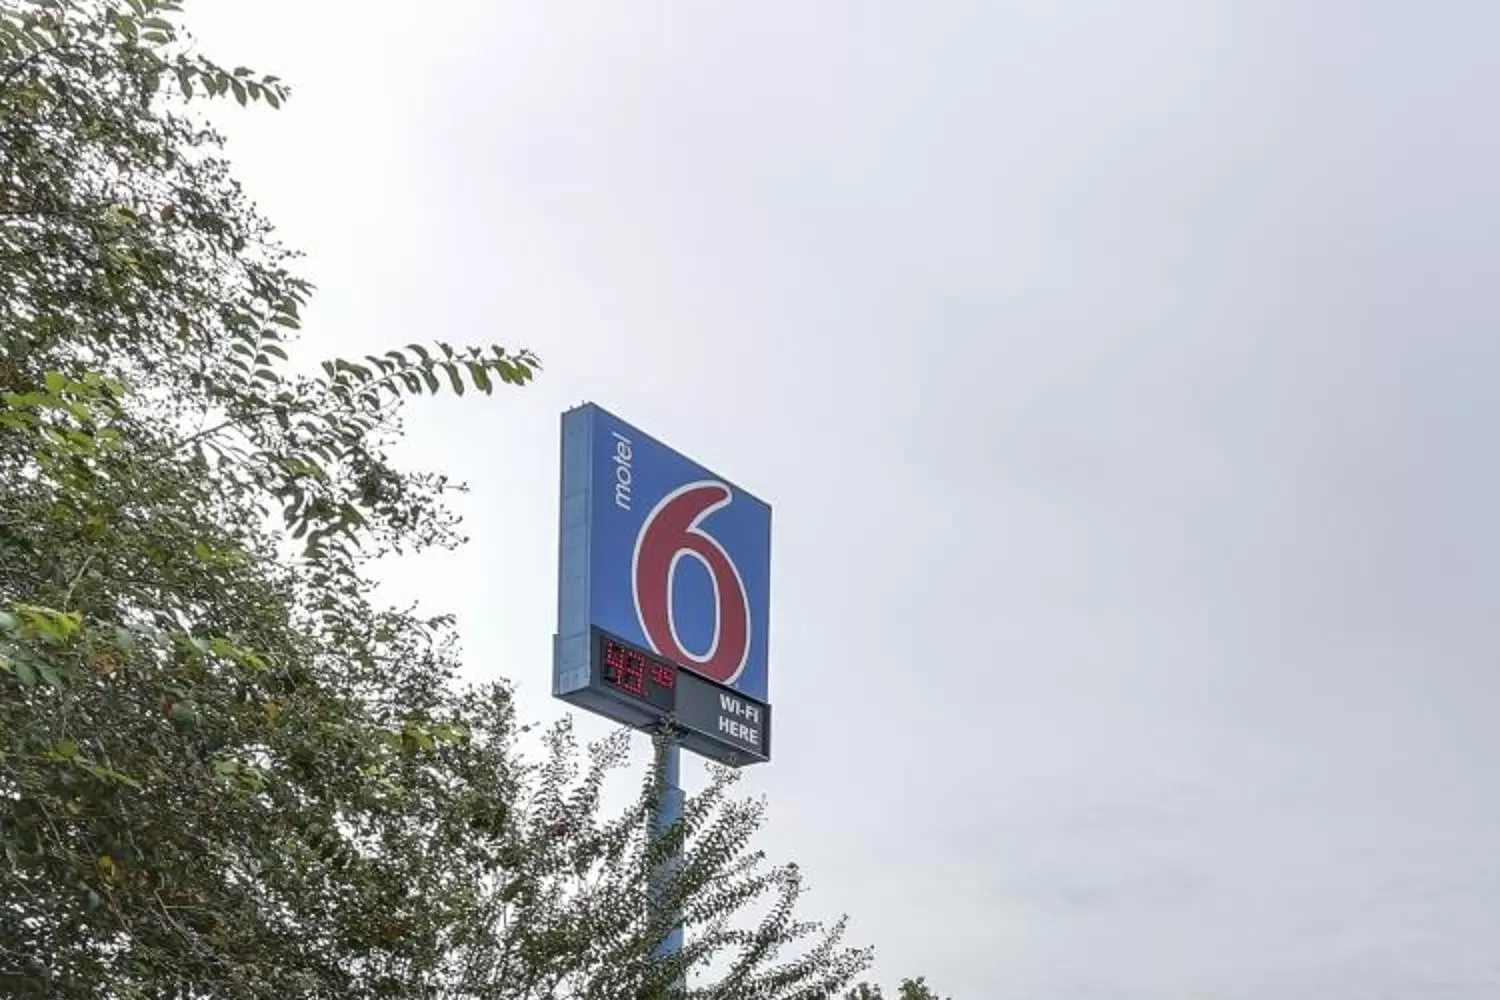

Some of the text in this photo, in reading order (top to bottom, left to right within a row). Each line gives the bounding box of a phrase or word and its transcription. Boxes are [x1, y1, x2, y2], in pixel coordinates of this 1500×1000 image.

[611, 431, 633, 511] motel
[631, 479, 751, 687] 6
[719, 693, 760, 724] WI-FI
[719, 715, 760, 745] HERE
